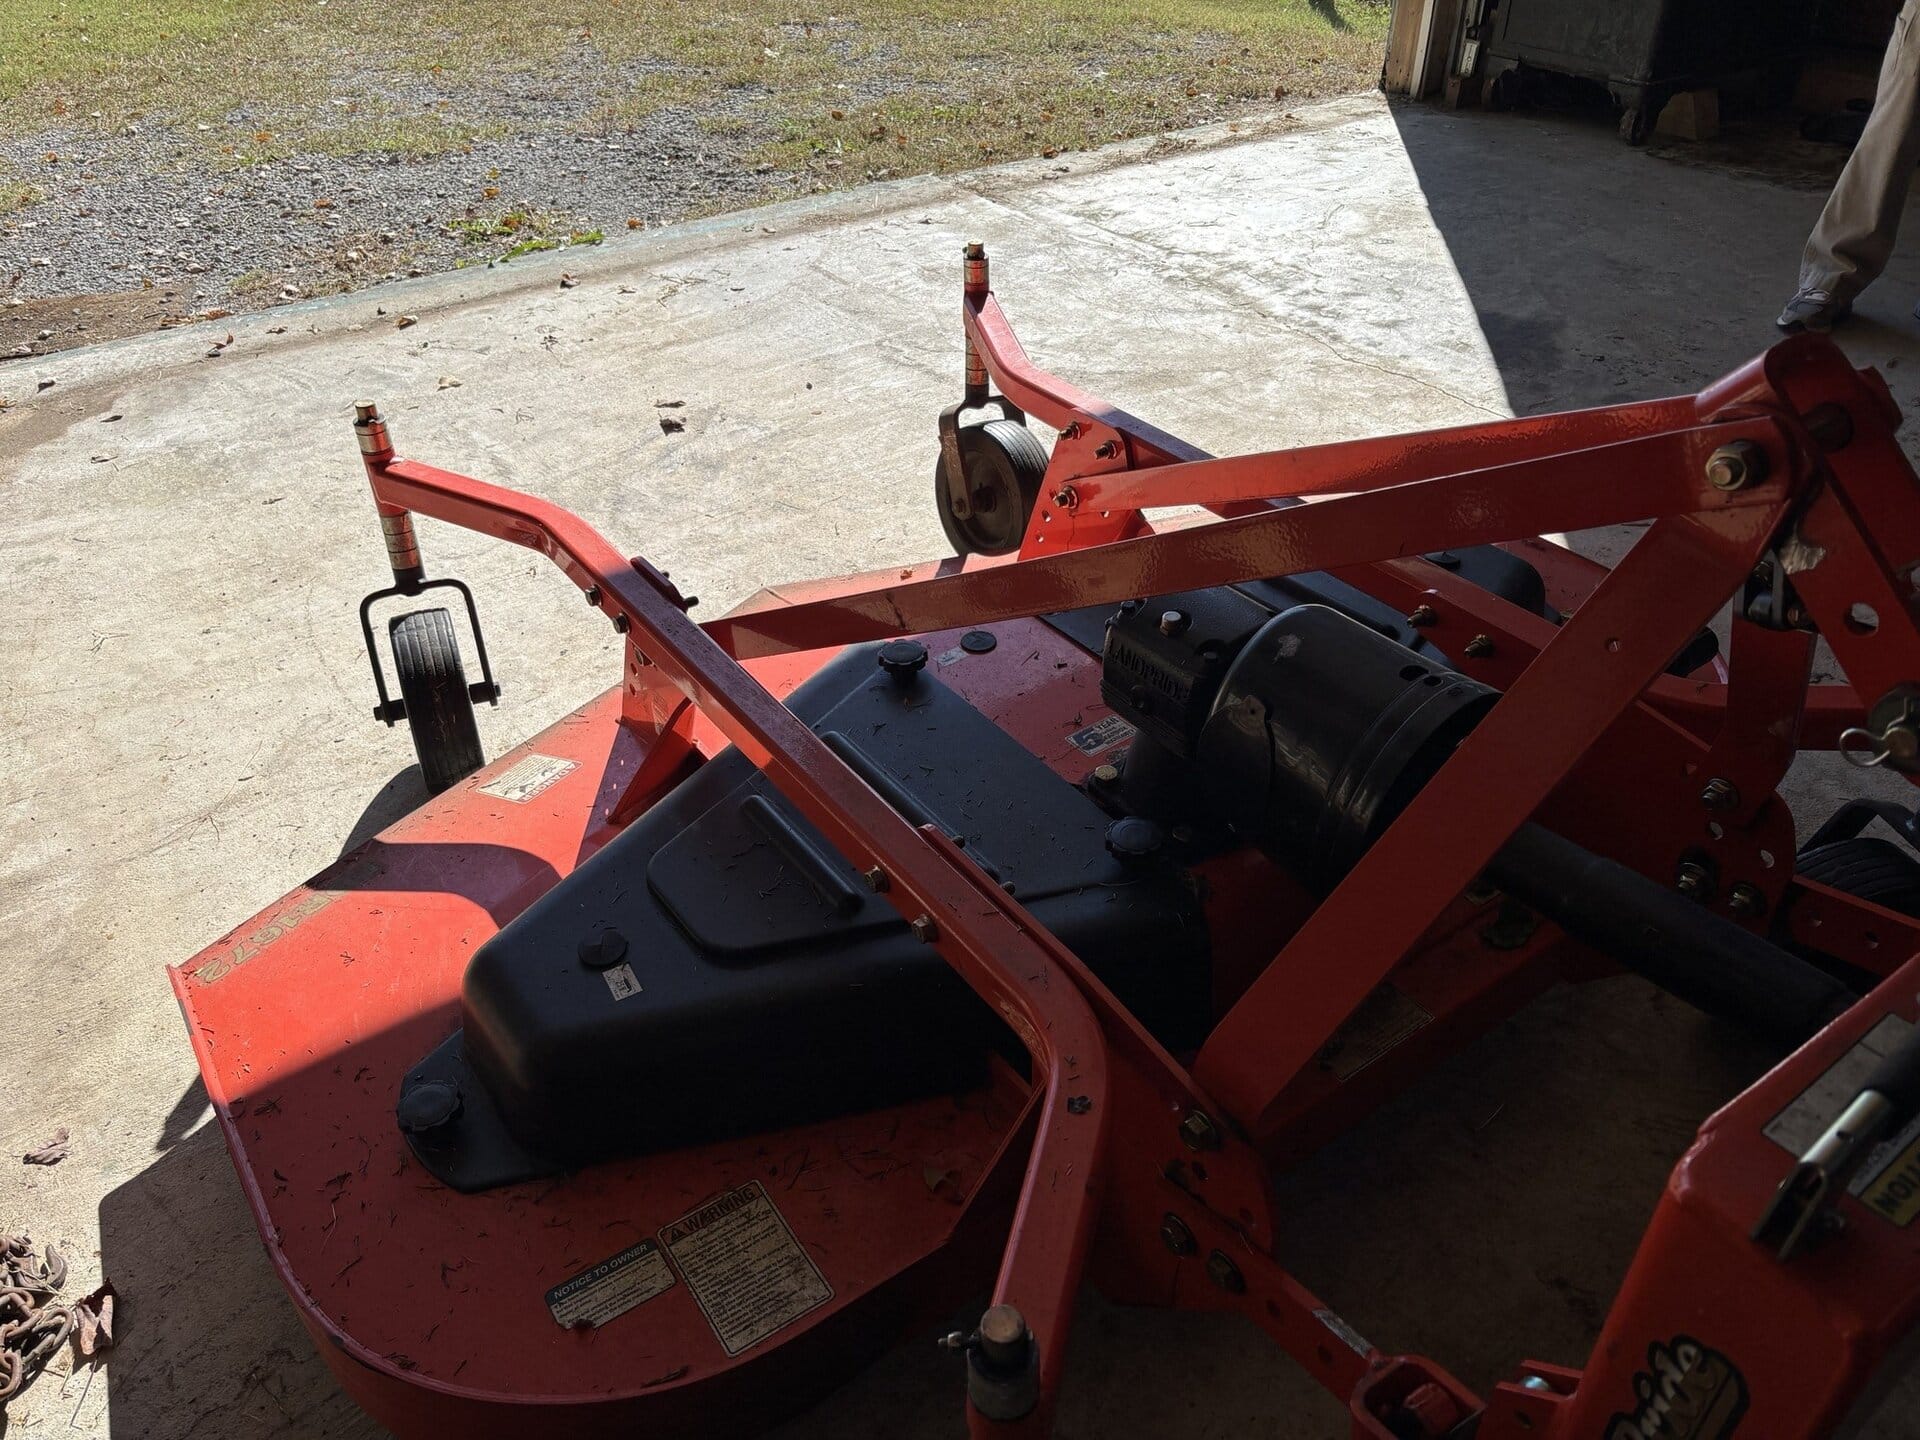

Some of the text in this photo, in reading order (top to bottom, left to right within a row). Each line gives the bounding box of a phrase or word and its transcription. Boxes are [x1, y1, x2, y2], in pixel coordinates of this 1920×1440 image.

[1096, 717, 1119, 730] YEAR
[684, 1186, 756, 1232] WARNING
[553, 1243, 648, 1300] NOTICE TO OWNER
